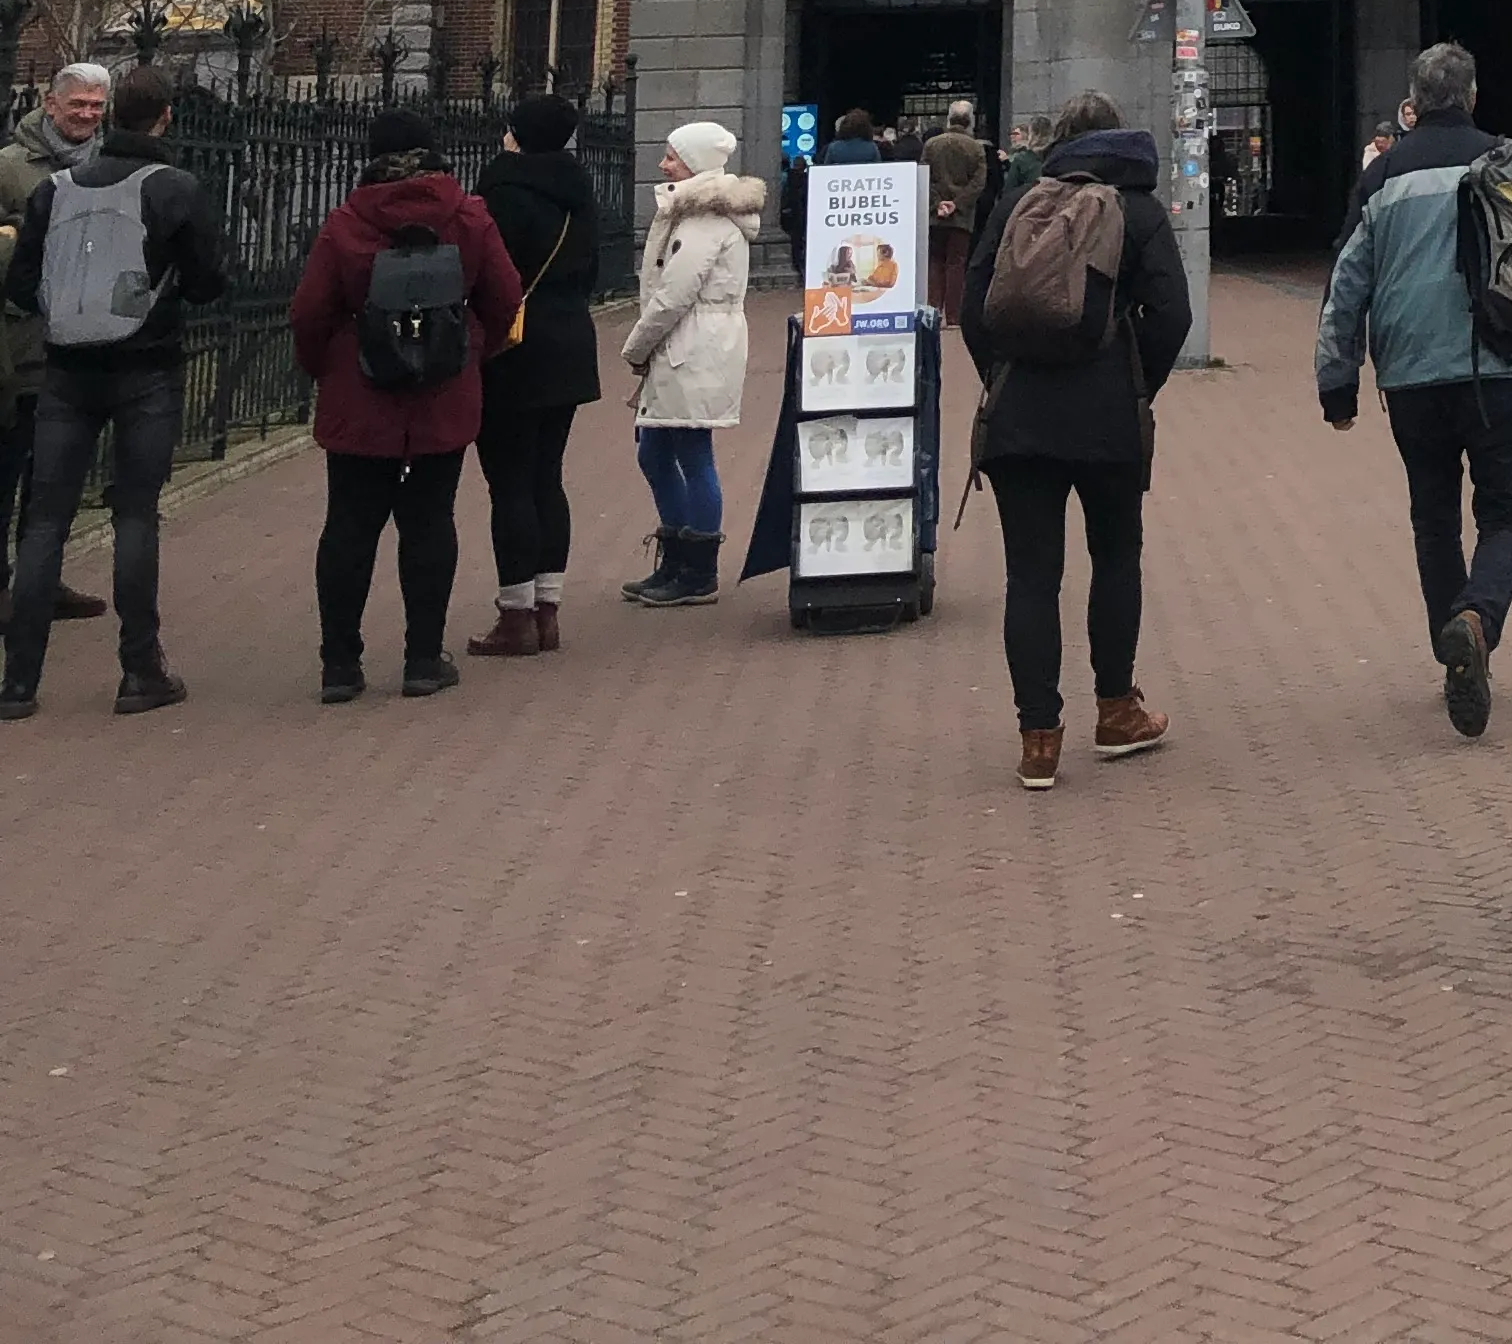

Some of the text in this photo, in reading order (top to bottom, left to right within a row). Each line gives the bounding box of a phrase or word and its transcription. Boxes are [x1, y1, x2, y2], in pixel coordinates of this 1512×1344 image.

[827, 177, 893, 193] GRATIS
[829, 195, 899, 210] BIJBEL-
[825, 211, 899, 227] CURSUS
[854, 318, 889, 328] JW.ORG
